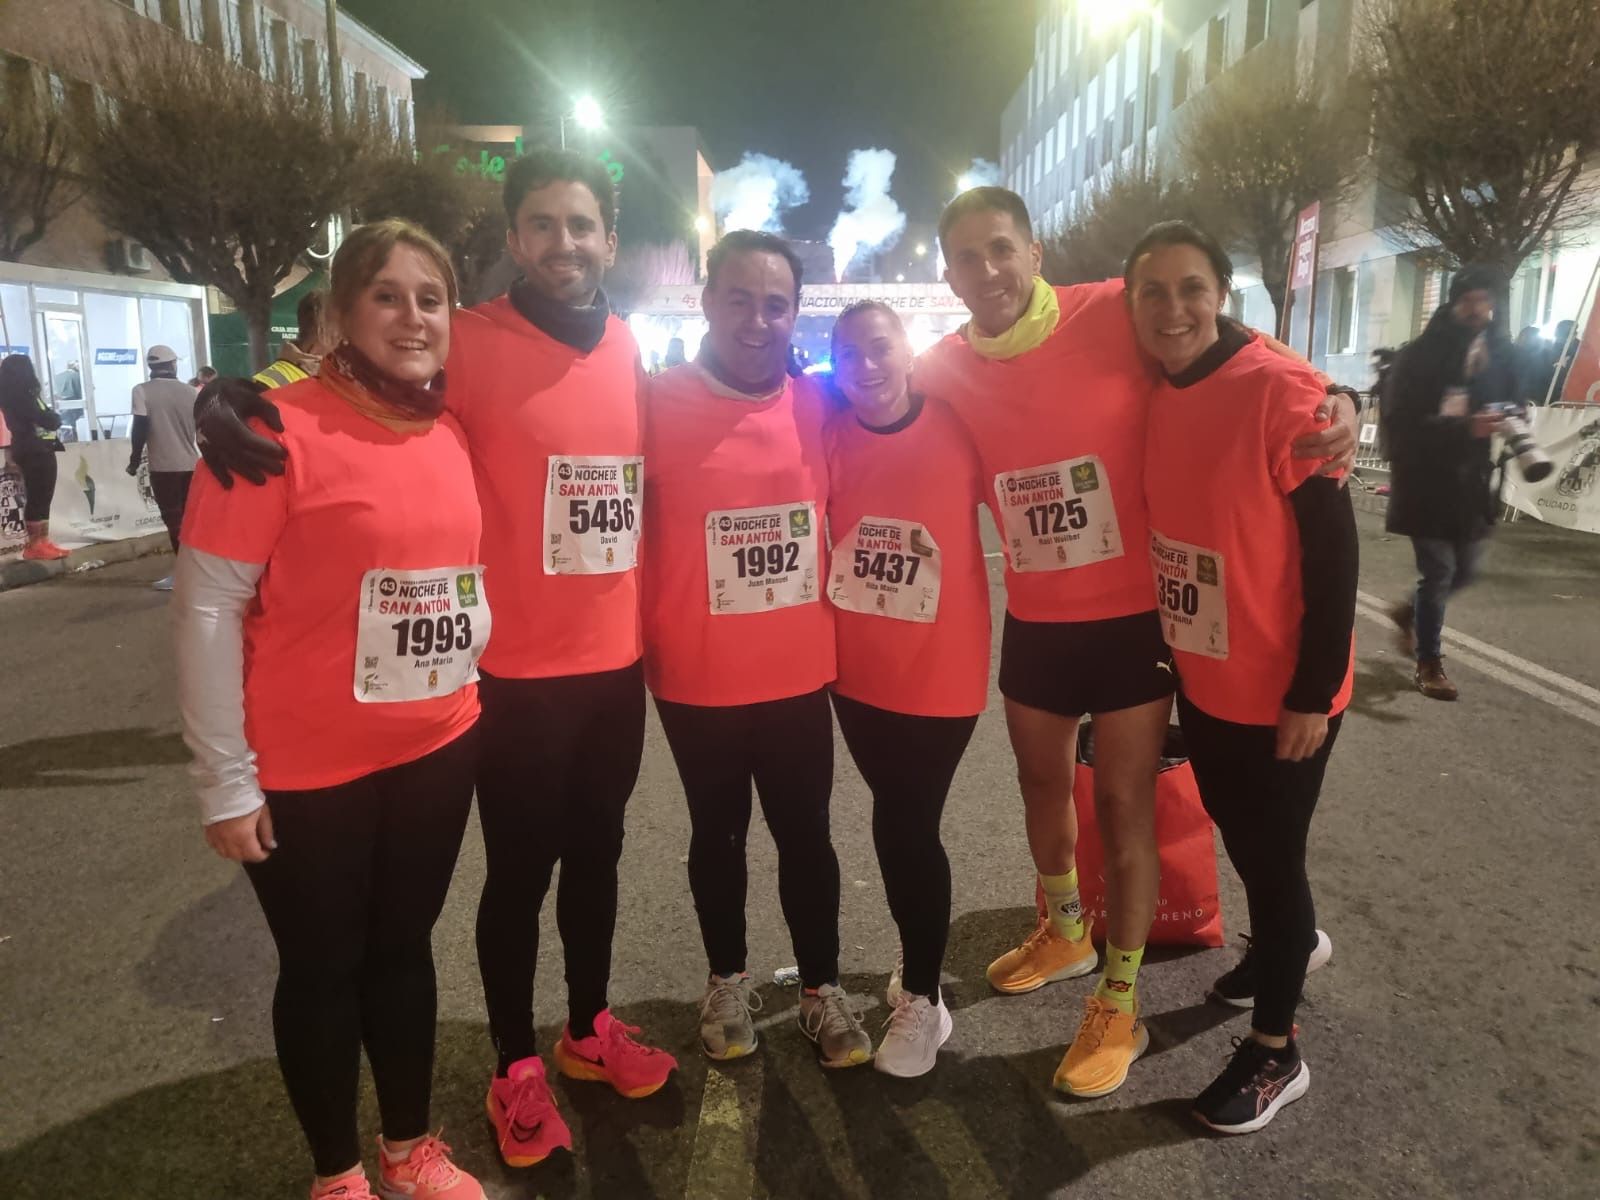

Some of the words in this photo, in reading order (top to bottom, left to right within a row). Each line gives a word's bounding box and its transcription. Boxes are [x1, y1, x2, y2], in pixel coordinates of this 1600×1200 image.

[575, 469, 608, 480] NOCHE
[610, 469, 617, 479] DE
[1018, 477, 1046, 491] NOCHE
[1049, 474, 1060, 485] DE
[559, 484, 585, 495] SAN
[1010, 494, 1029, 506] SAN
[1031, 487, 1063, 502] ANTÓN
[569, 498, 634, 533] 5436
[734, 518, 767, 530] NOCHE
[769, 517, 780, 527] DE
[1024, 497, 1087, 536] 1725
[600, 536, 617, 544] David
[720, 534, 743, 545] SAN
[746, 529, 781, 544] ANTÓN
[889, 530, 901, 539] DE
[869, 538, 901, 551] ANTÓN
[732, 541, 799, 578] 1992
[853, 549, 920, 585] 5437
[1177, 554, 1188, 565] DE
[398, 583, 435, 598] NOCHE
[437, 582, 448, 594] DE
[1158, 573, 1198, 615] 350
[379, 600, 411, 614] SAN
[413, 596, 450, 614] ANTÓN
[391, 613, 471, 656] 1993
[414, 659, 429, 667] Ana
[1154, 908, 1203, 920] RENO
